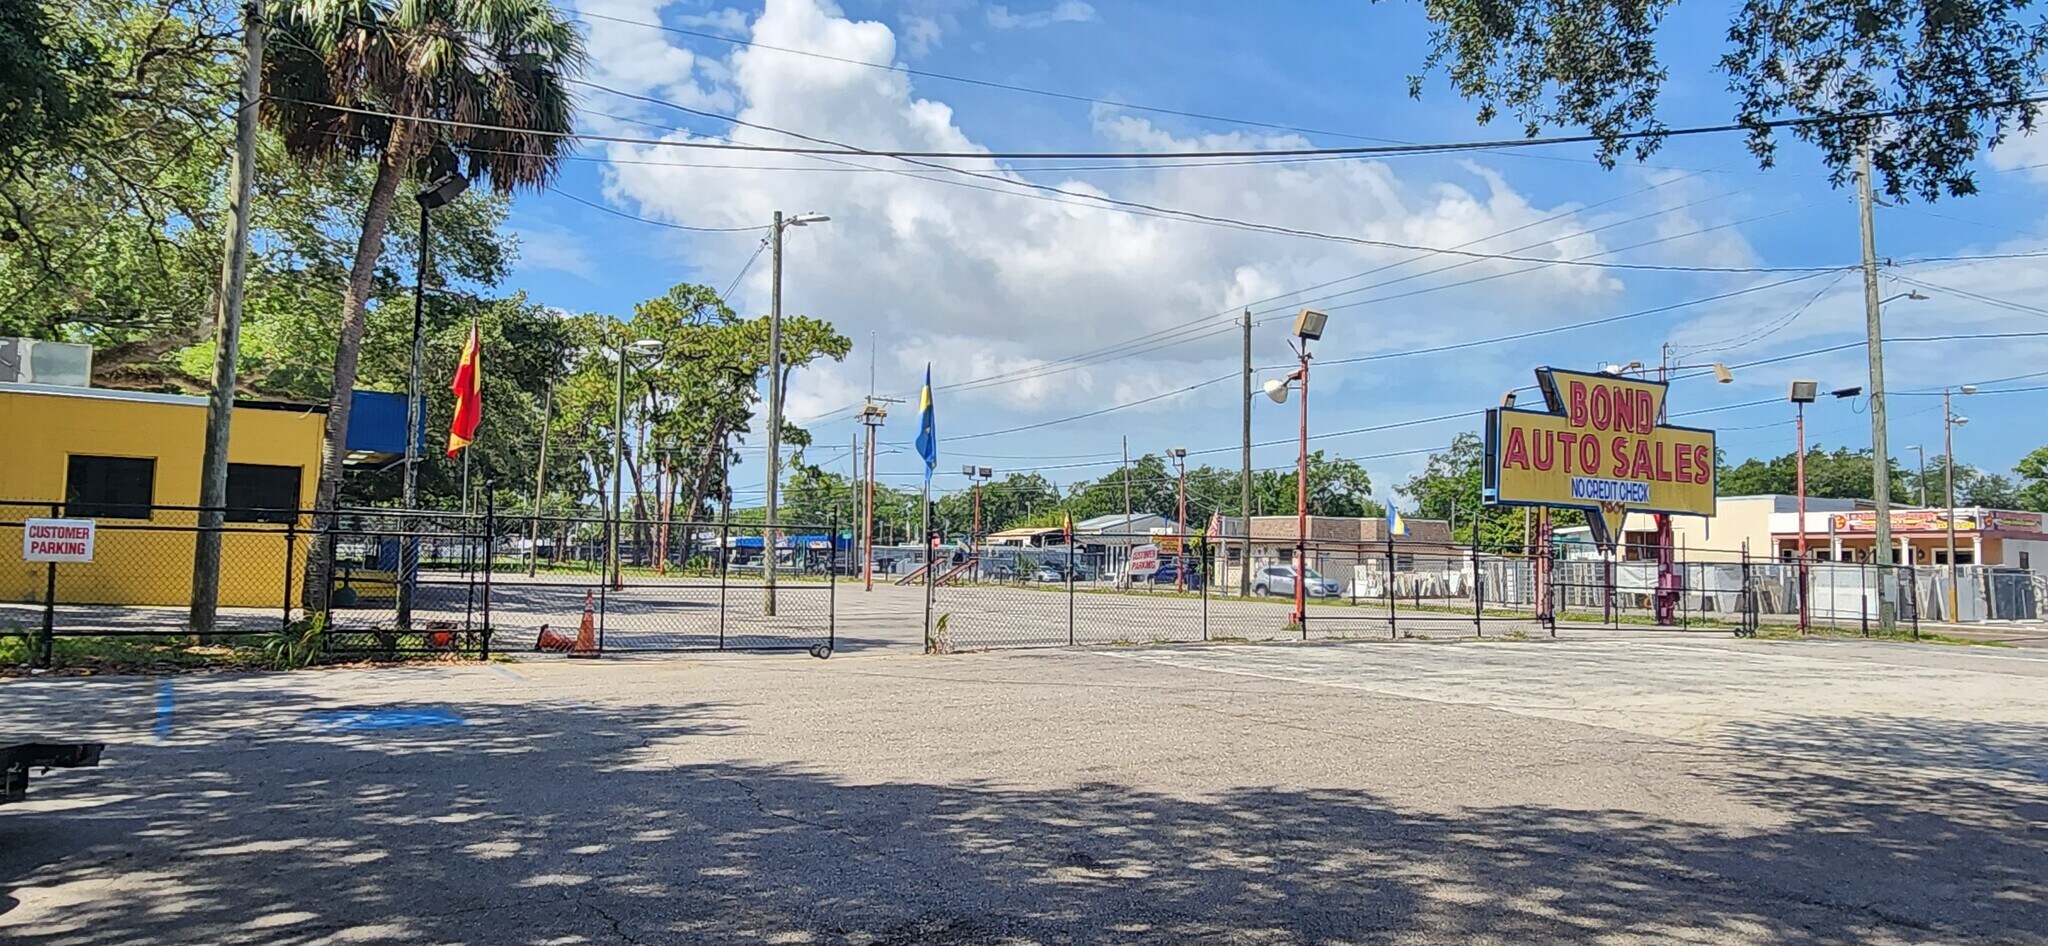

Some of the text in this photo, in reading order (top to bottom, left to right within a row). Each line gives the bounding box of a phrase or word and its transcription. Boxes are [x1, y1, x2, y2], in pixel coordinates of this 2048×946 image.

[1569, 380, 1654, 435] BOND
[1503, 427, 1711, 485] AUTO SALES
[1571, 478, 1650, 502] NO CREDIT CHECK
[29, 526, 89, 539] CUSTOMER
[31, 541, 86, 554] PARKING
[1133, 550, 1155, 560] CUSTOMER
[1132, 561, 1155, 570] PARKING
